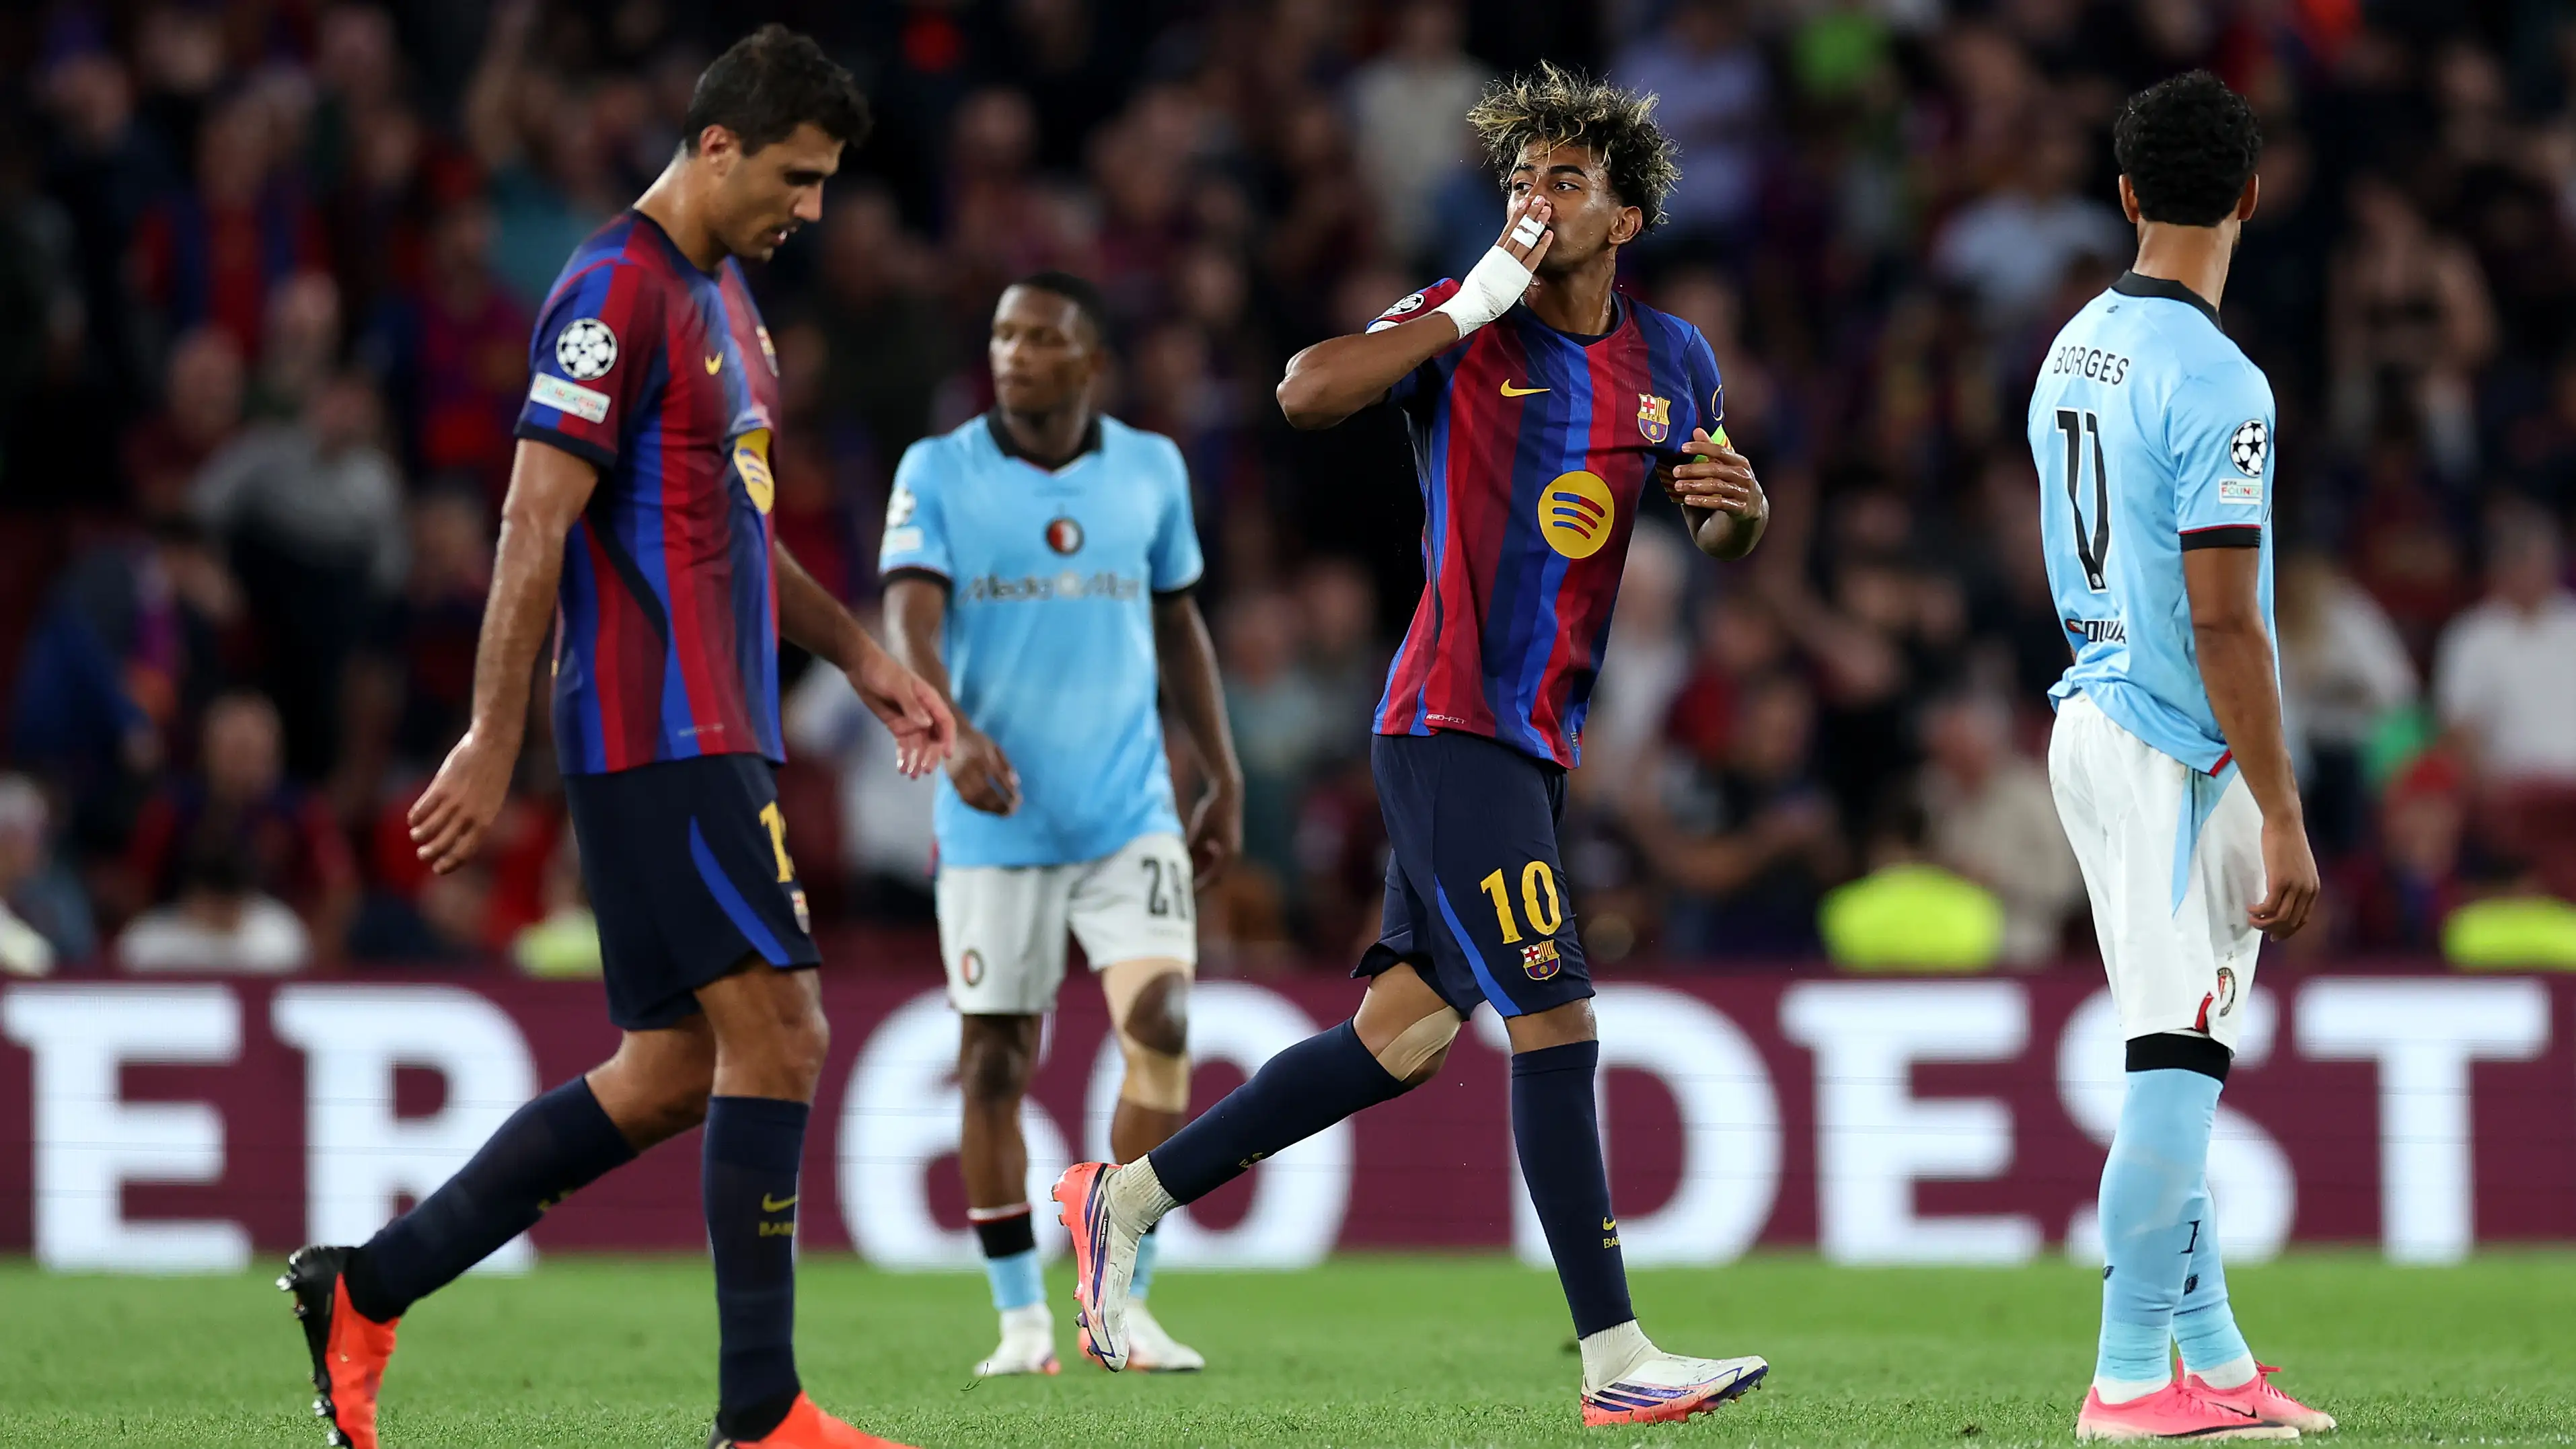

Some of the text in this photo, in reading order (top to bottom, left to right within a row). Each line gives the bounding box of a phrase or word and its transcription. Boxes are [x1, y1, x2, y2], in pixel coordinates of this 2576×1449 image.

[2053, 346, 2129, 385] BORGES
[2056, 409, 2109, 590] 11
[759, 799, 795, 883] 1
[1480, 860, 1562, 944] 10
[2, 979, 2552, 1275] ER 60 DEST
